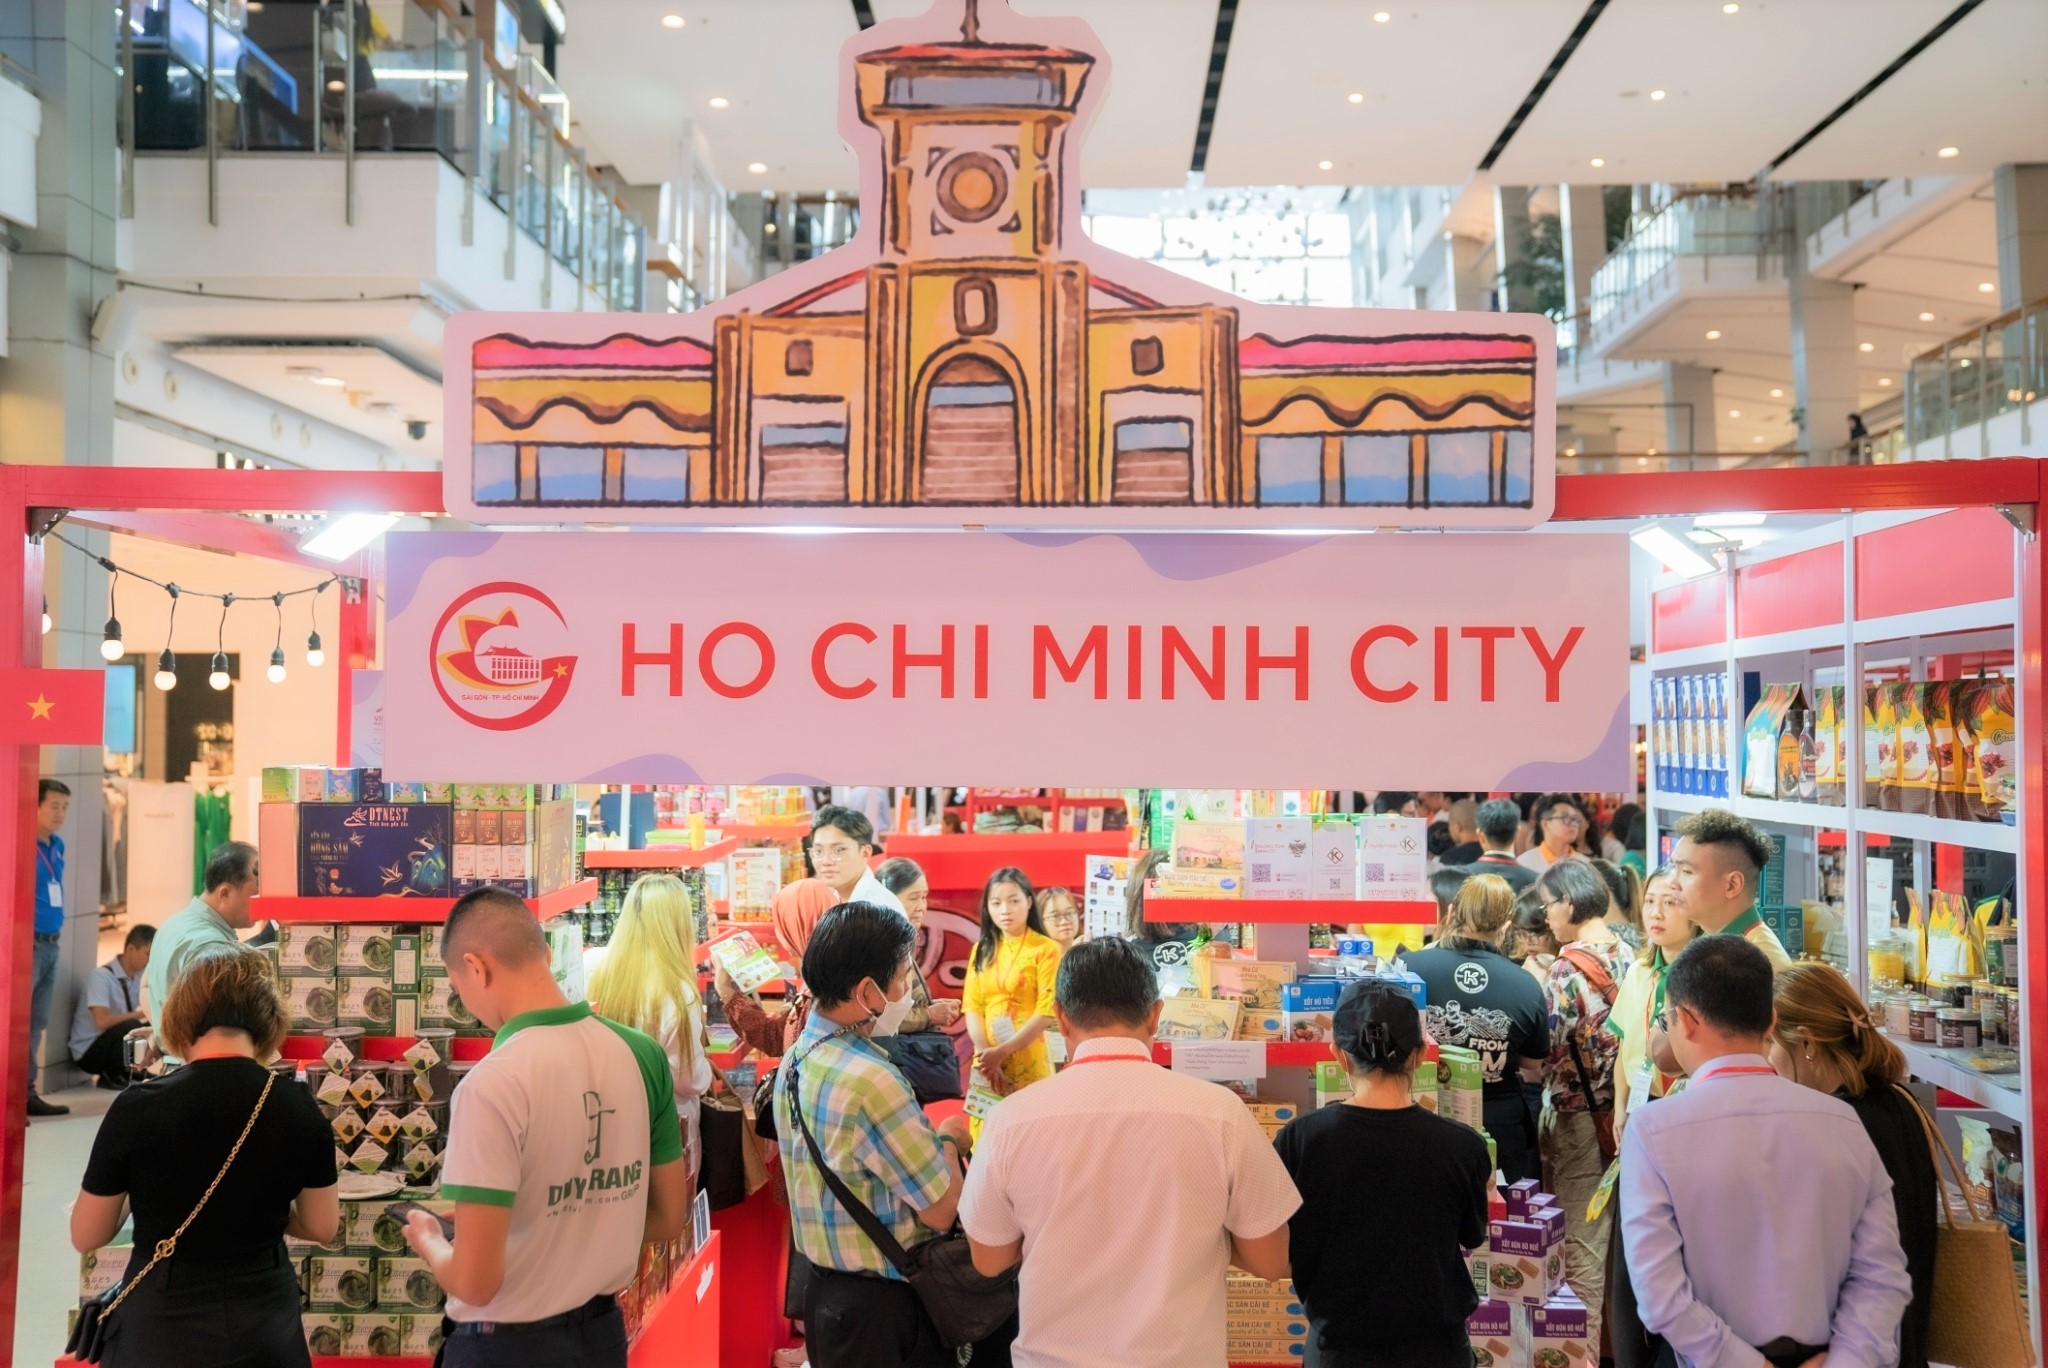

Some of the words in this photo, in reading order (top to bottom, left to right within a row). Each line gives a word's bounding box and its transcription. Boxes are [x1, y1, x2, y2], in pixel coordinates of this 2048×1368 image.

[621, 621, 776, 699] HO
[810, 624, 989, 700] CHI
[1032, 624, 1310, 701] MINH
[1350, 624, 1585, 703] CITY
[369, 807, 409, 821] DTNEST
[1468, 1037, 1509, 1051] FROM
